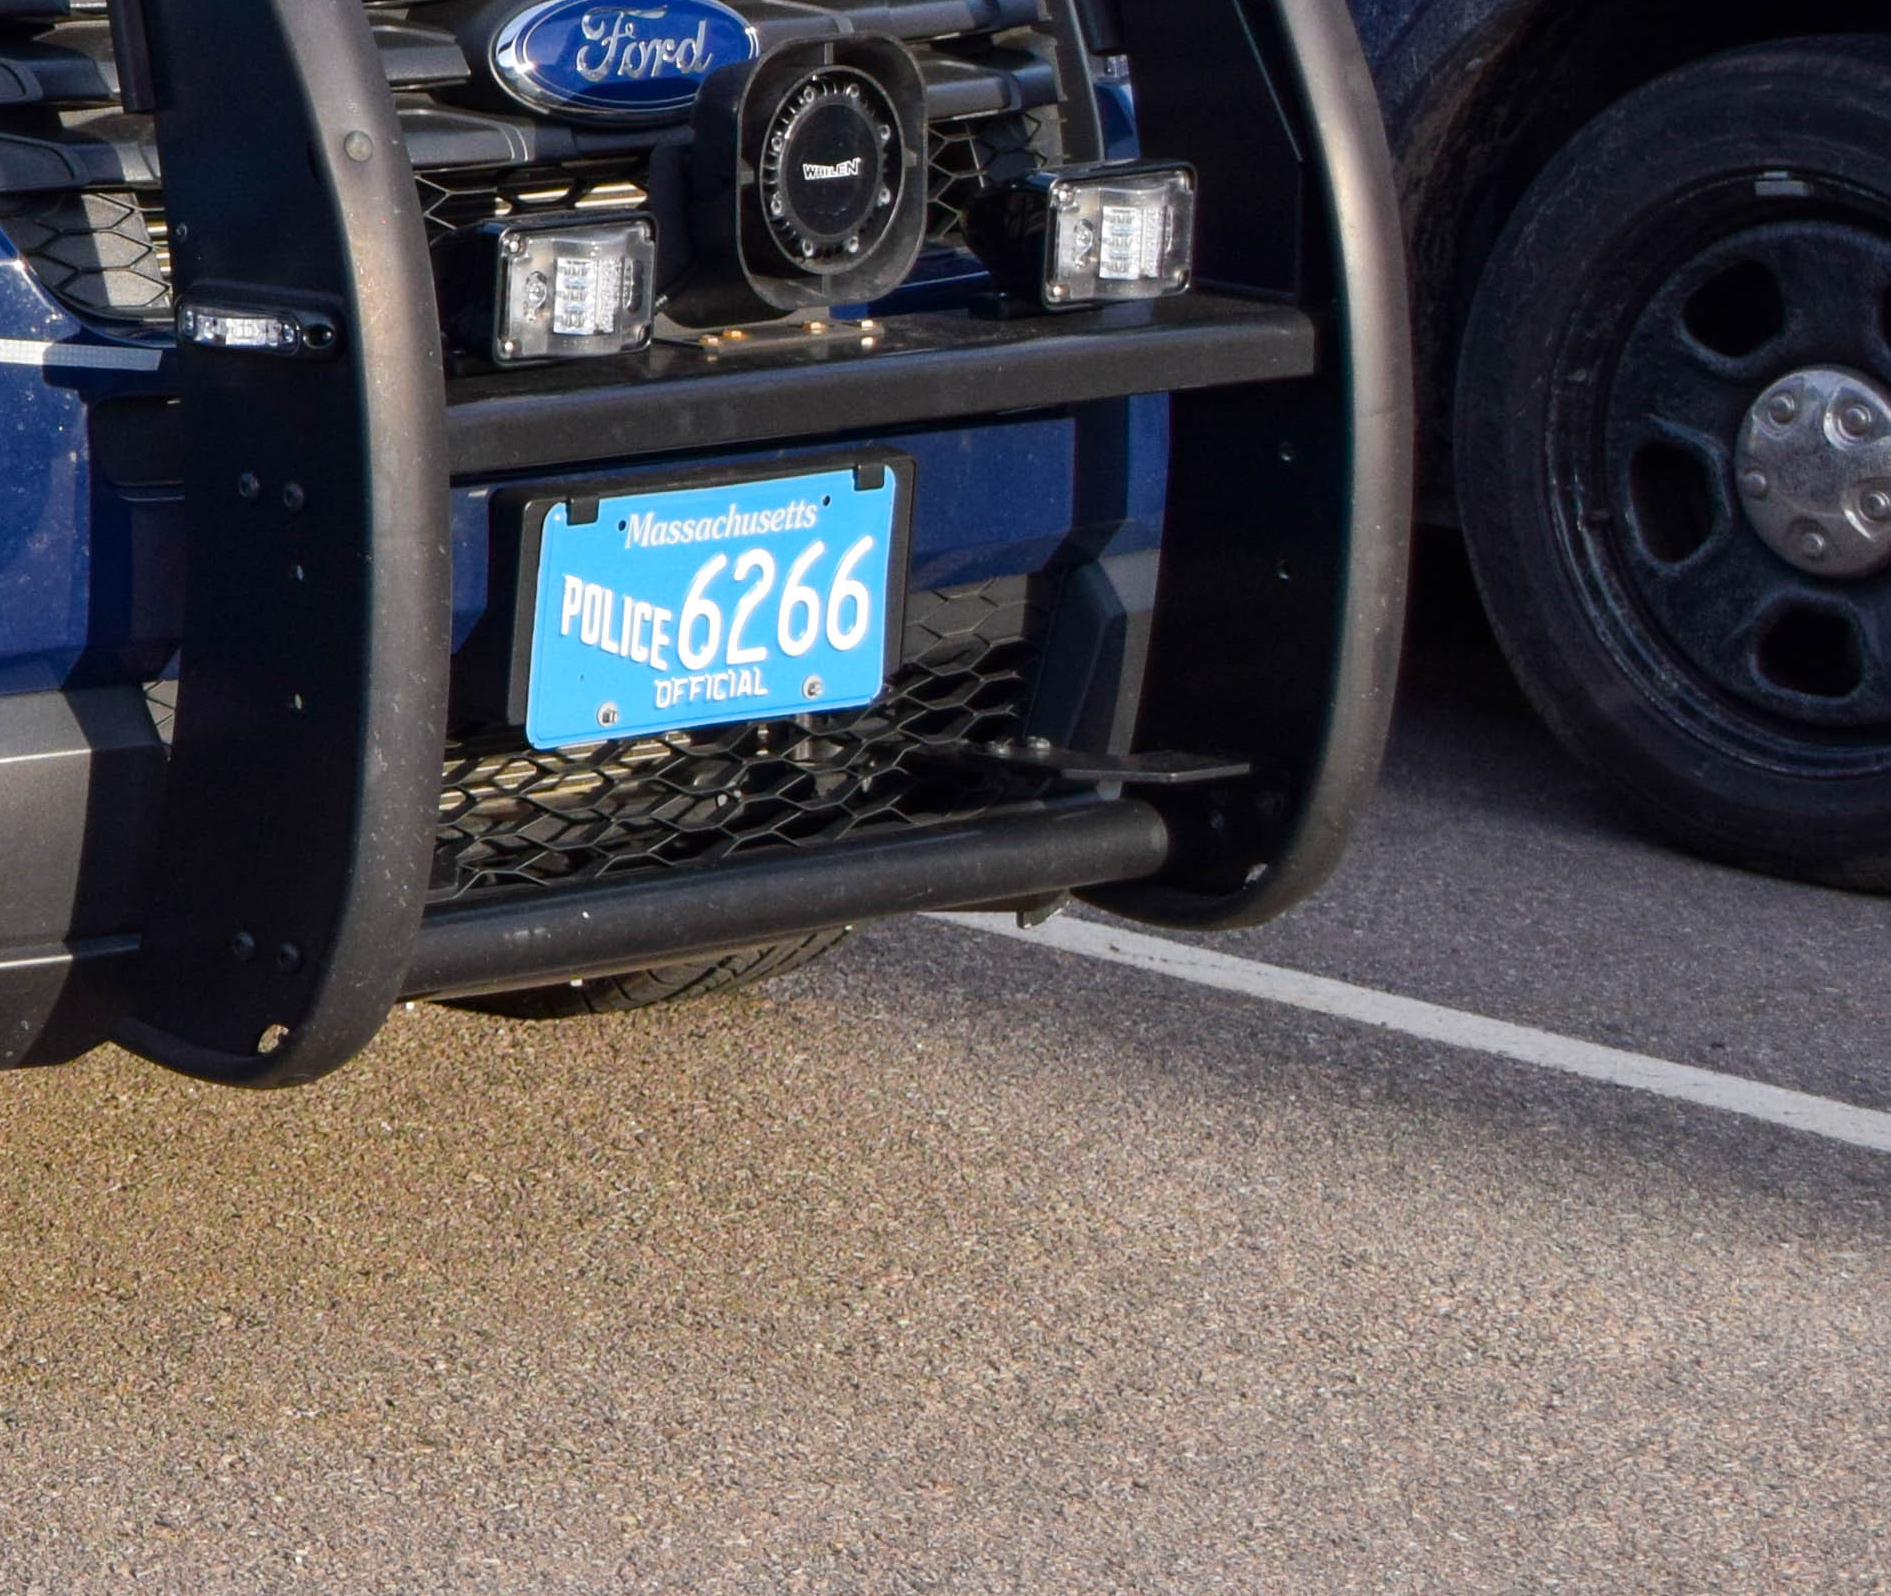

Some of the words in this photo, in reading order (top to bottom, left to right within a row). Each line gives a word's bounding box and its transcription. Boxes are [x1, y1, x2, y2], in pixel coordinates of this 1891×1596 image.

[576, 5, 713, 82] Ford
[624, 500, 817, 549] Massachusetts
[561, 574, 672, 671] POLICE
[677, 535, 874, 671] 6266
[654, 667, 768, 708] OFFICIAL
